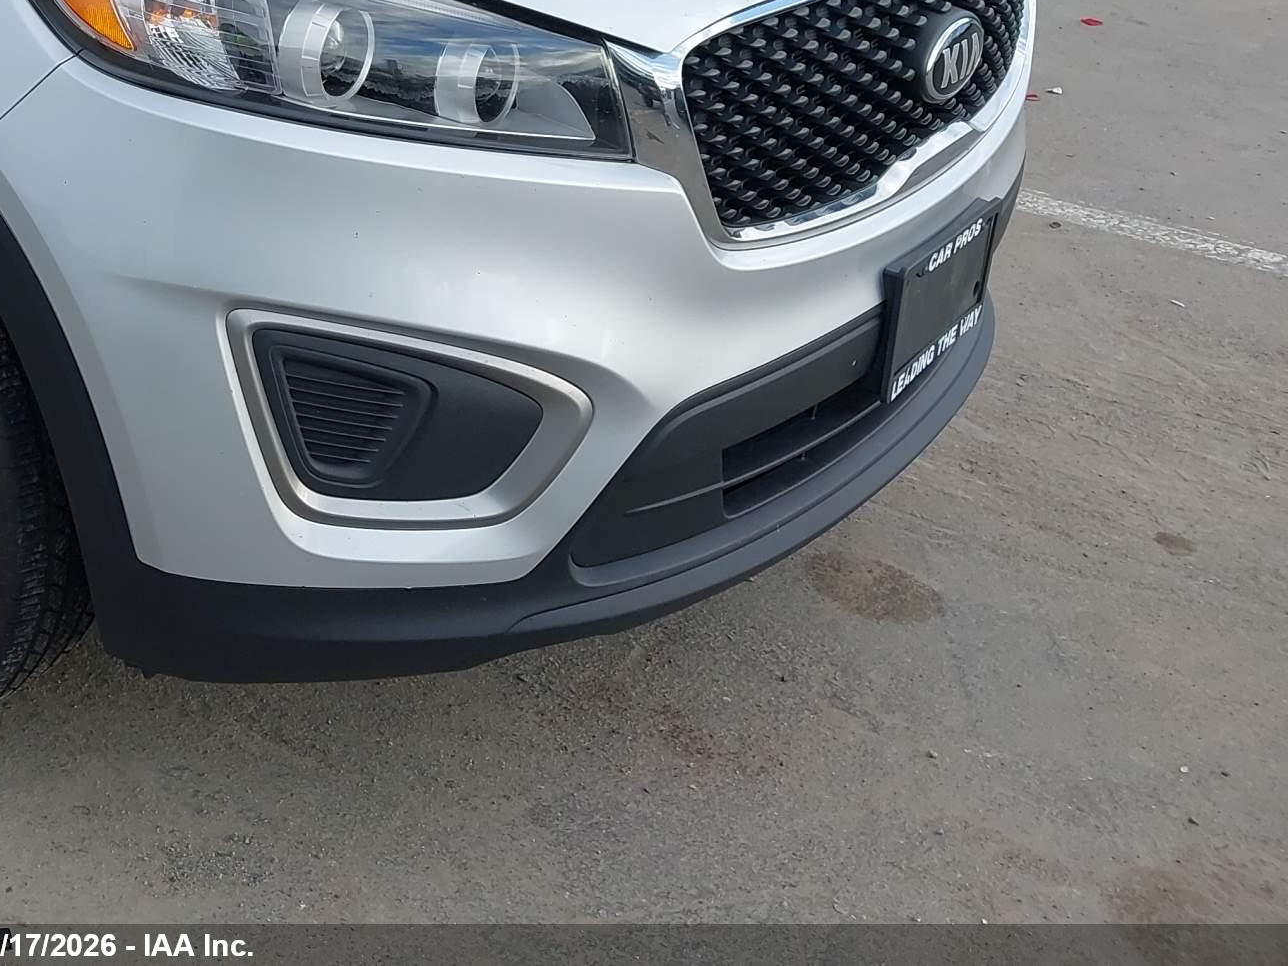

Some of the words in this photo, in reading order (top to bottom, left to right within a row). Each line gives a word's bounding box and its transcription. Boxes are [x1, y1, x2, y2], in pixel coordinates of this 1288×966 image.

[928, 241, 954, 272] CAR
[953, 217, 983, 254] PROS
[890, 344, 935, 403] LEADING
[937, 323, 958, 357] THE
[959, 304, 982, 337] WAY
